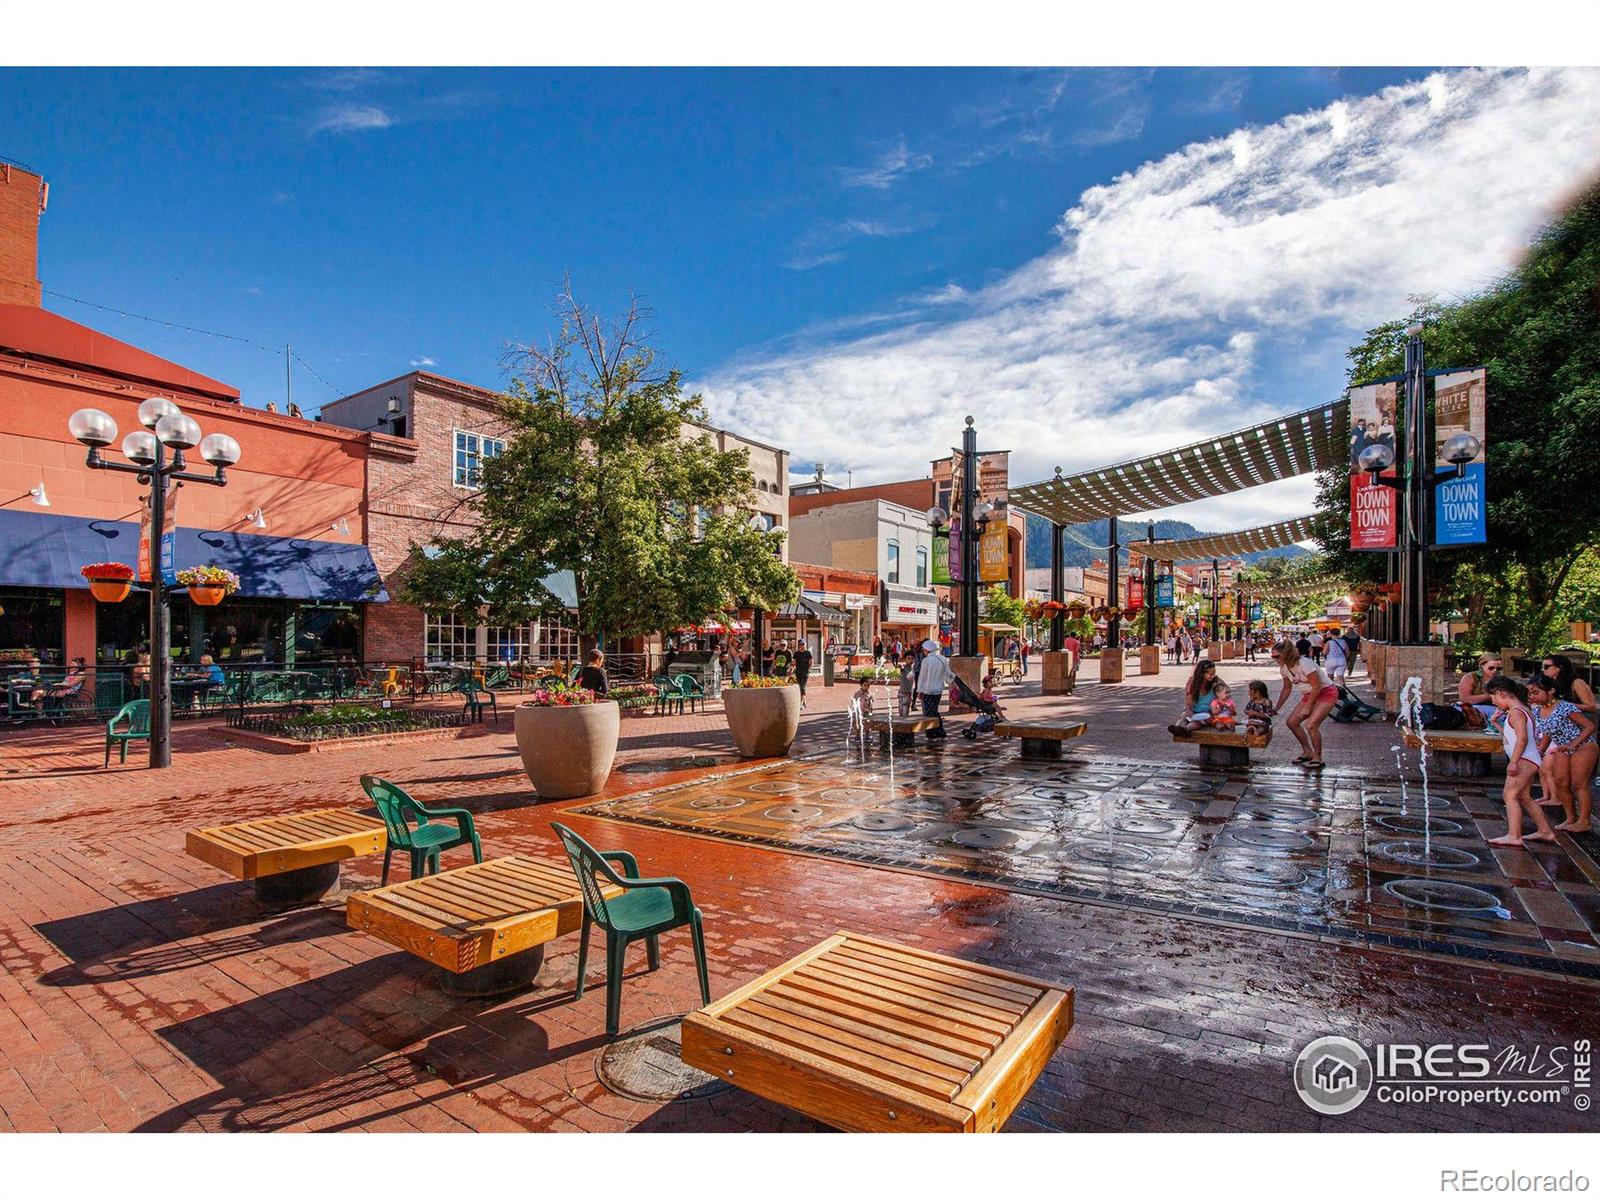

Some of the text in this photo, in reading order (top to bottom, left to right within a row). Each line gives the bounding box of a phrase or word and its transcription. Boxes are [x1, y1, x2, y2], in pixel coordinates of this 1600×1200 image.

[1356, 490, 1390, 509] DOWN
[1442, 482, 1479, 503] DOWN
[1356, 508, 1390, 528] TOWN
[1442, 502, 1479, 522] TOWN
[984, 535, 1004, 549] DOWN
[984, 549, 1004, 564] TOWN
